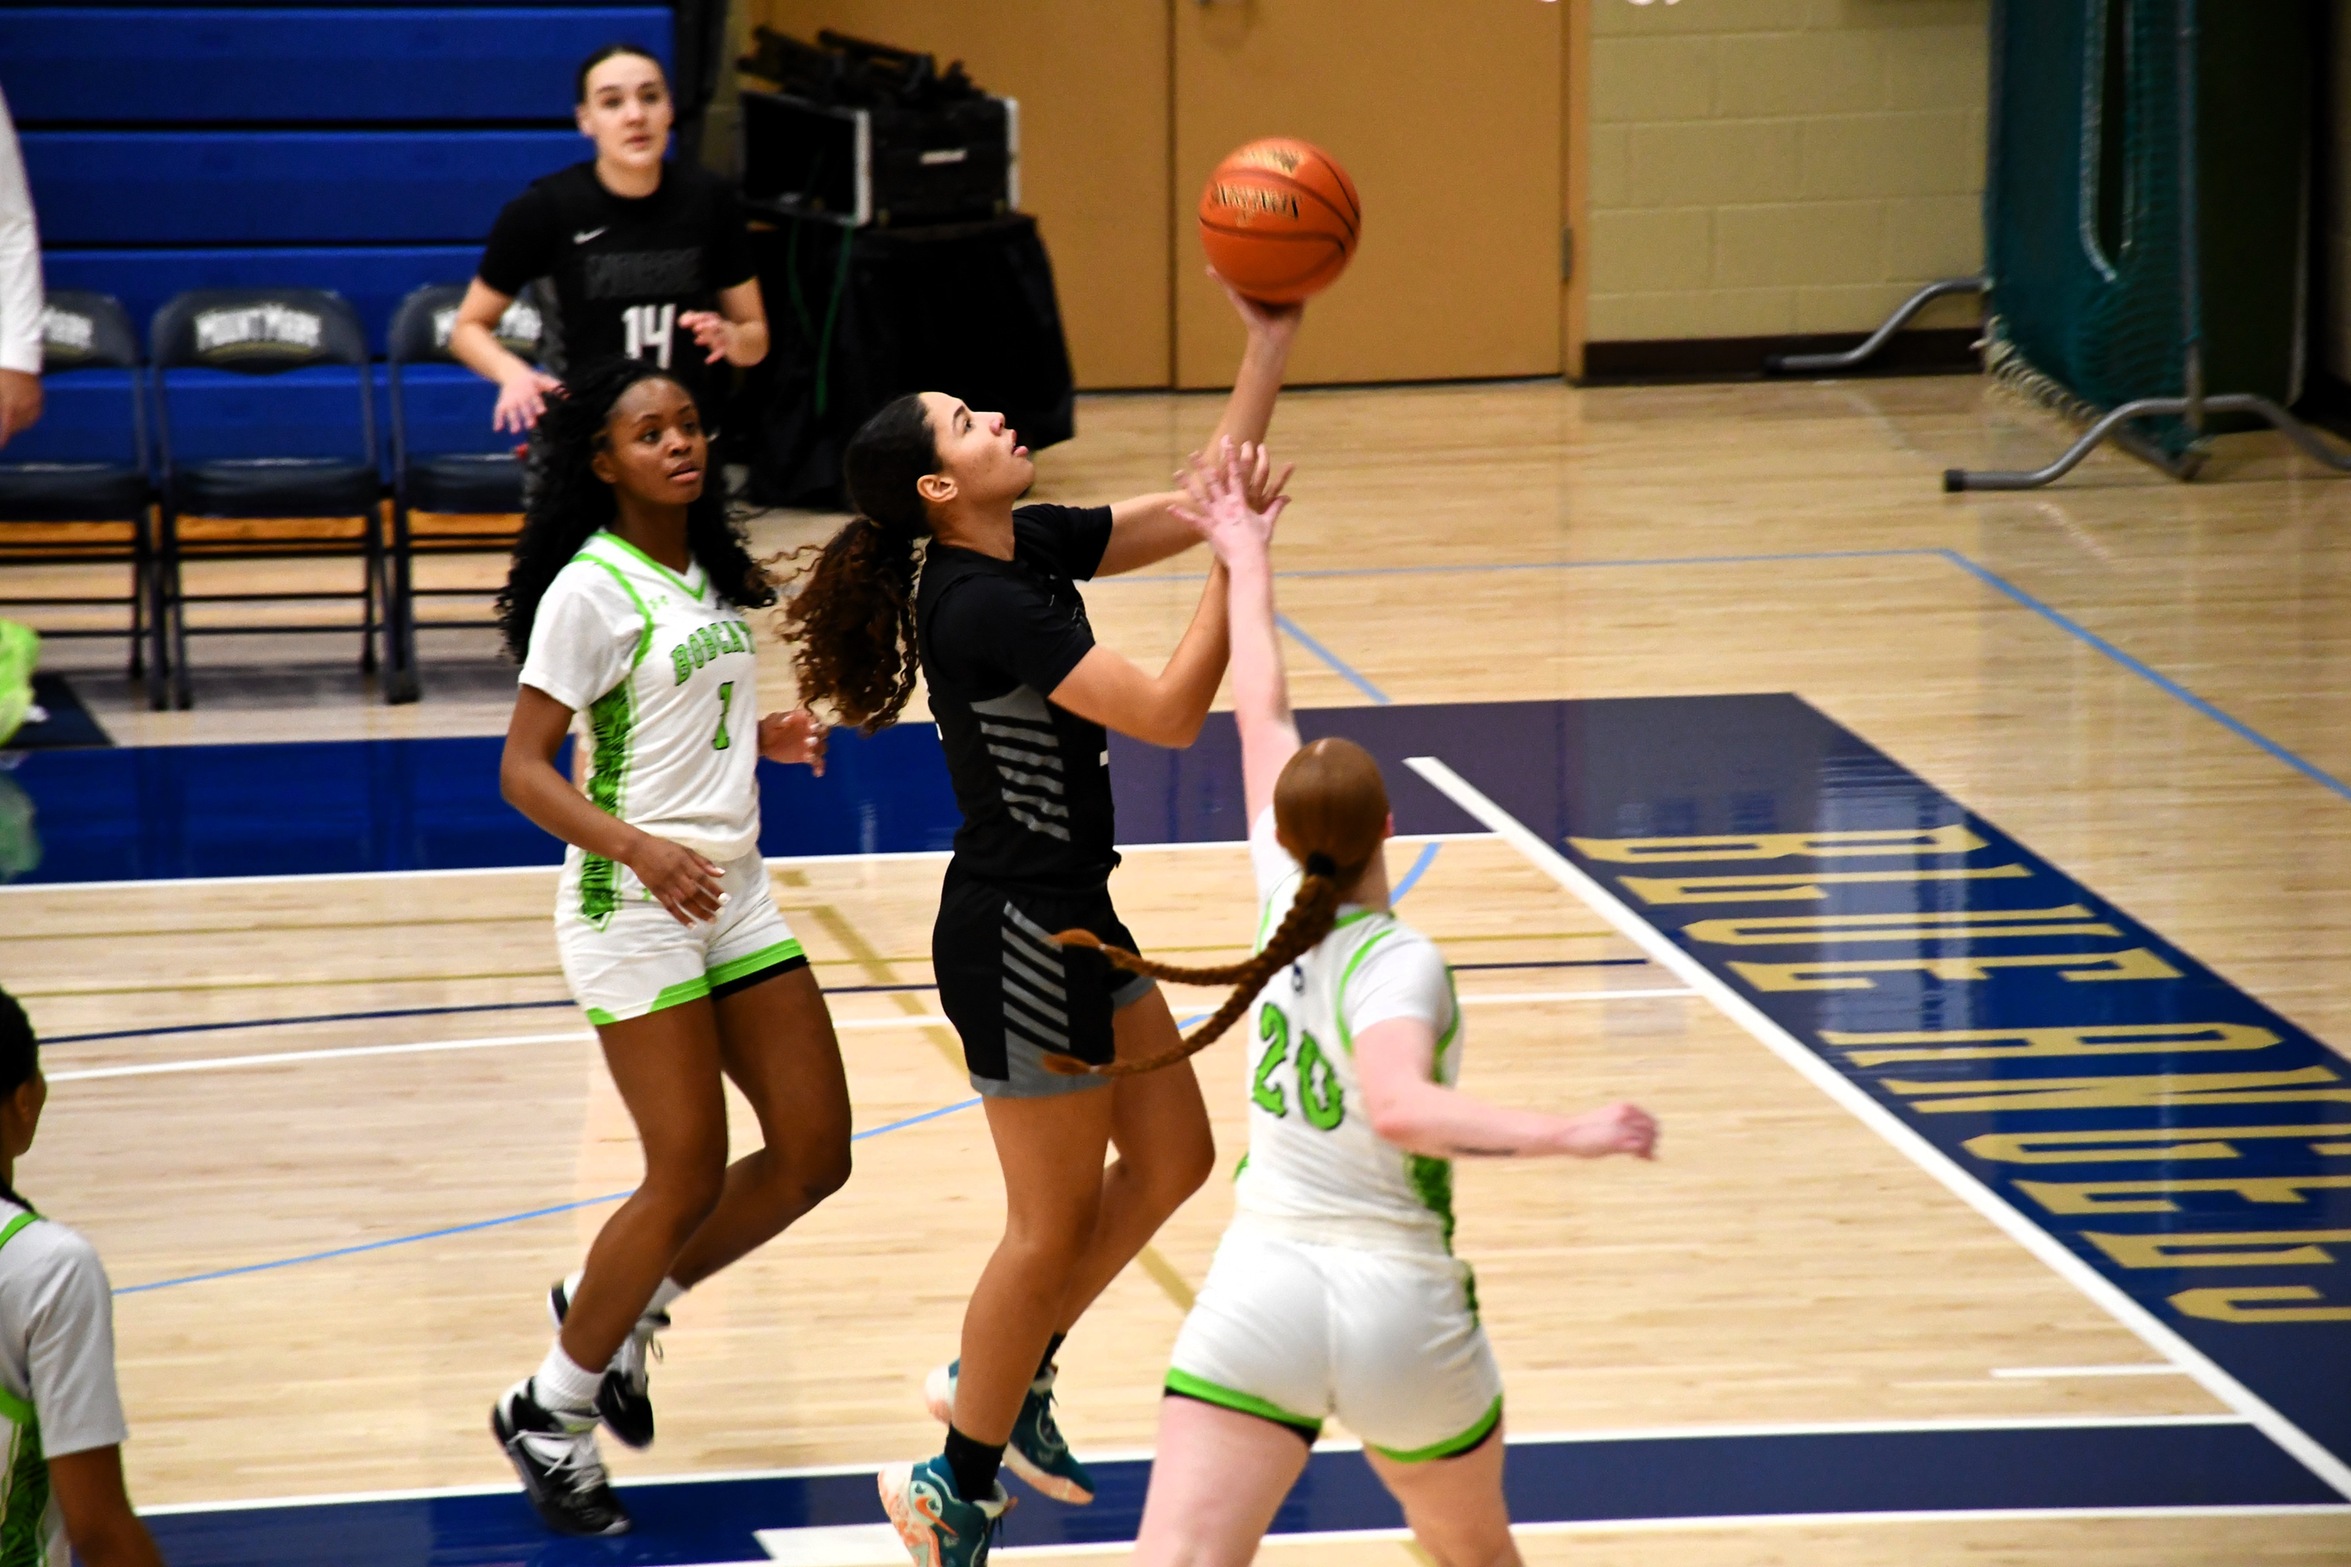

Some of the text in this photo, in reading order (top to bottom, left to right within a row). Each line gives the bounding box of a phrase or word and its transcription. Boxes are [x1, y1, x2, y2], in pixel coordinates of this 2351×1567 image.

[621, 303, 677, 370] 14
[1564, 823, 2187, 993] BLUE
[1252, 1001, 1345, 1131] 20
